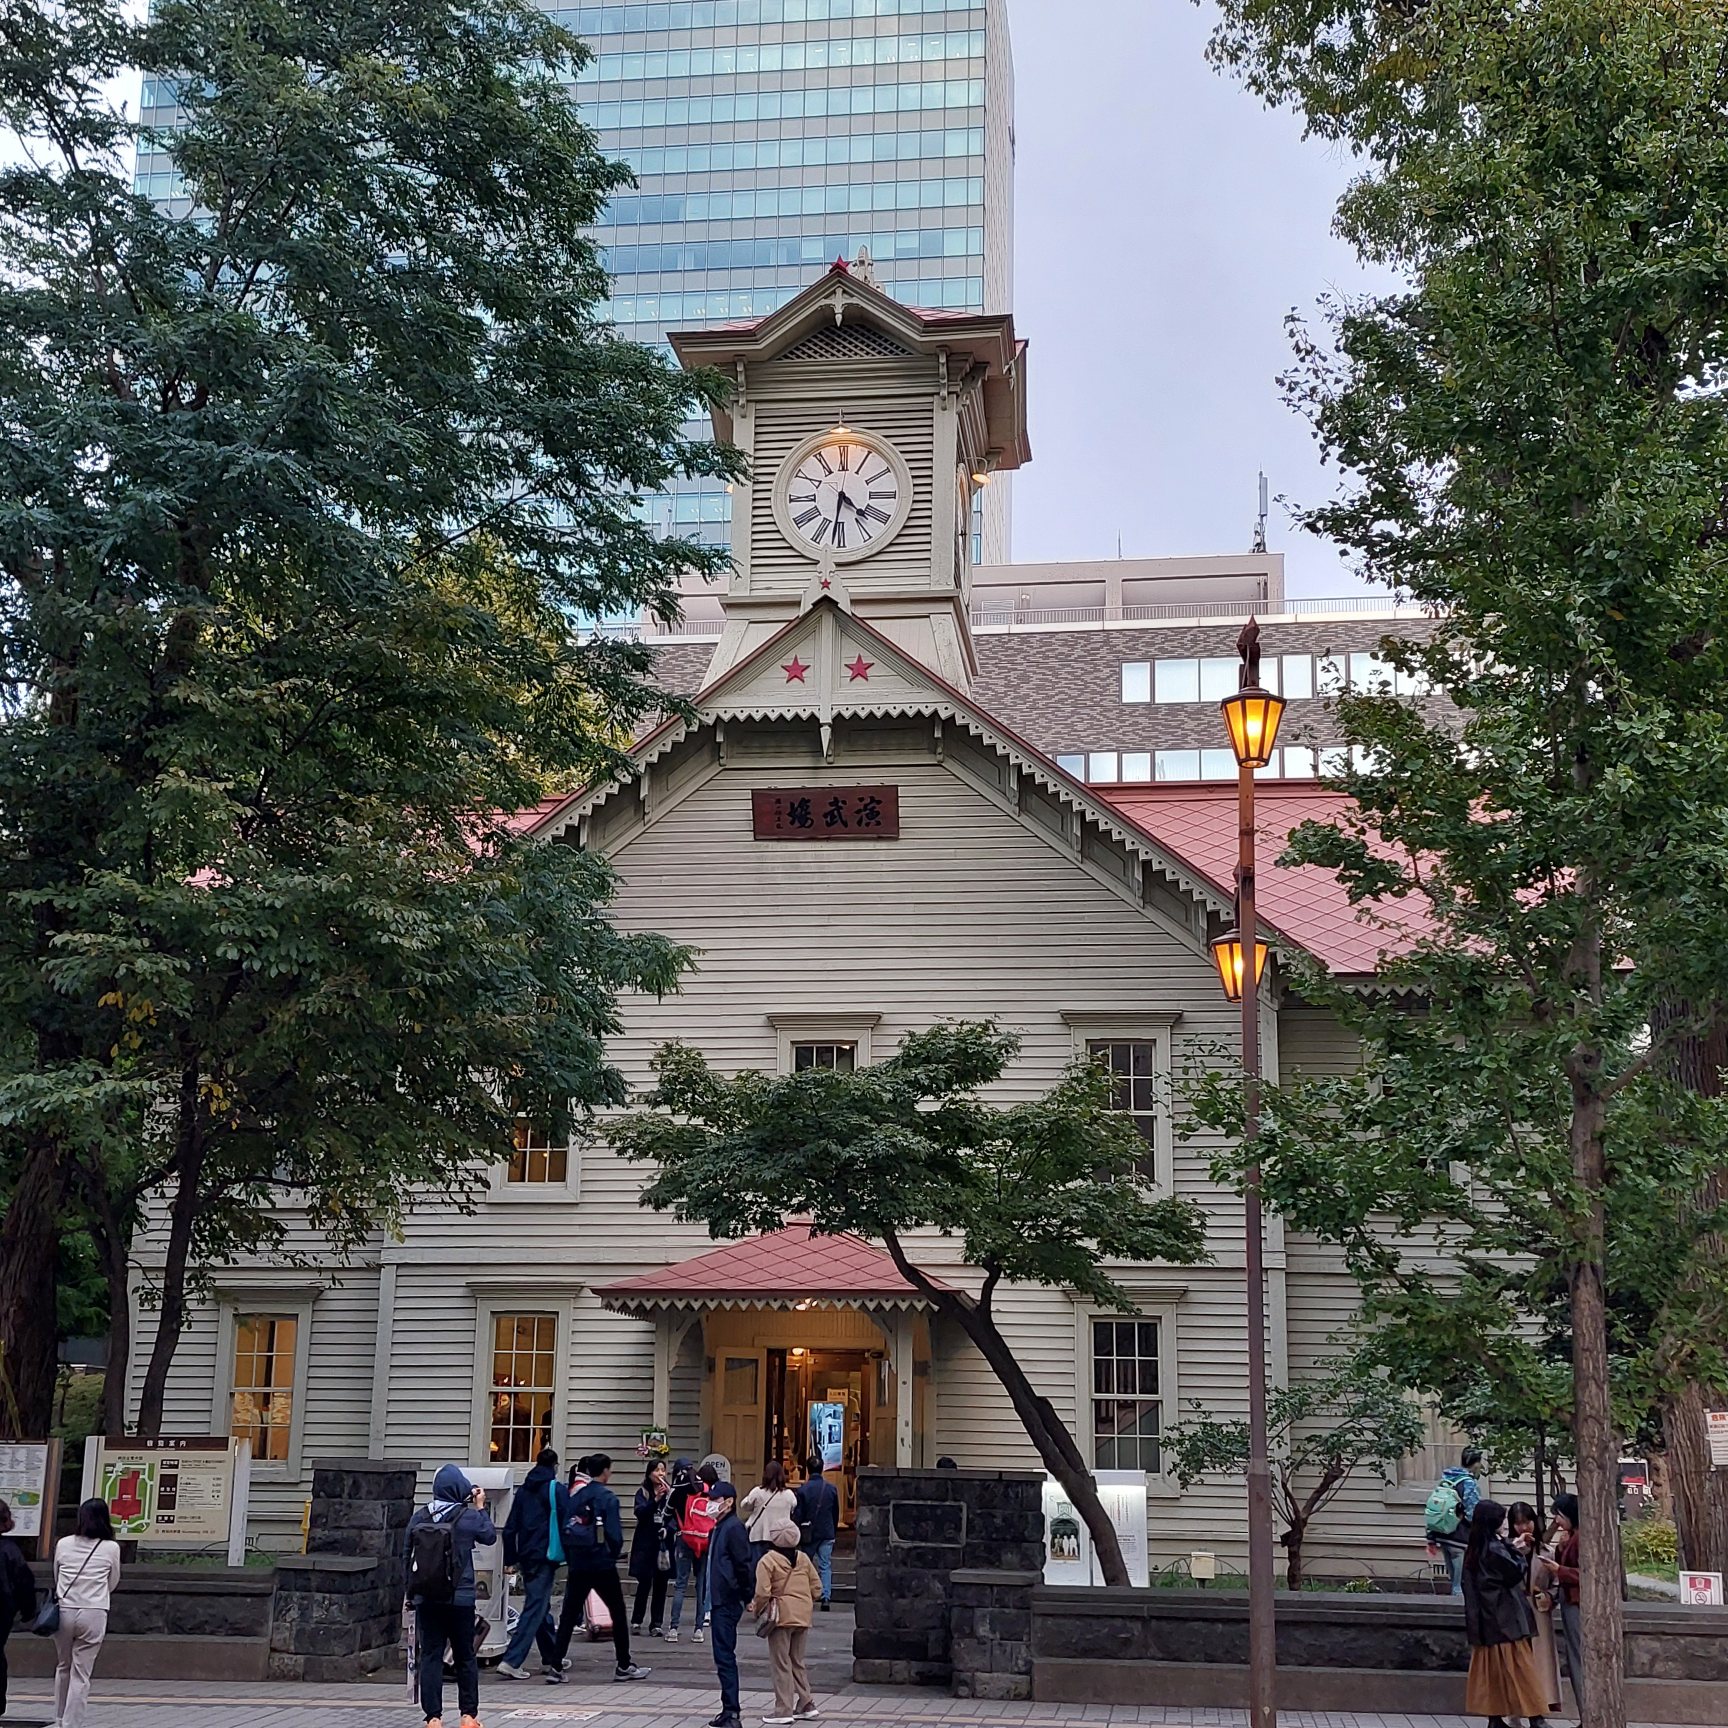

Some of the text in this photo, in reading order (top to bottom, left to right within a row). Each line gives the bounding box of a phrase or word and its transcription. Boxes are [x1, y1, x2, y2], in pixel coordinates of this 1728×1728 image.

[813, 451, 834, 477] XI
[838, 446, 849, 472] XII
[794, 468, 822, 489] X
[865, 466, 891, 486] II
[789, 493, 816, 504] IX
[869, 490, 897, 500] III
[792, 504, 822, 530] VIII
[855, 517, 873, 543] V
[810, 516, 833, 545] VII
